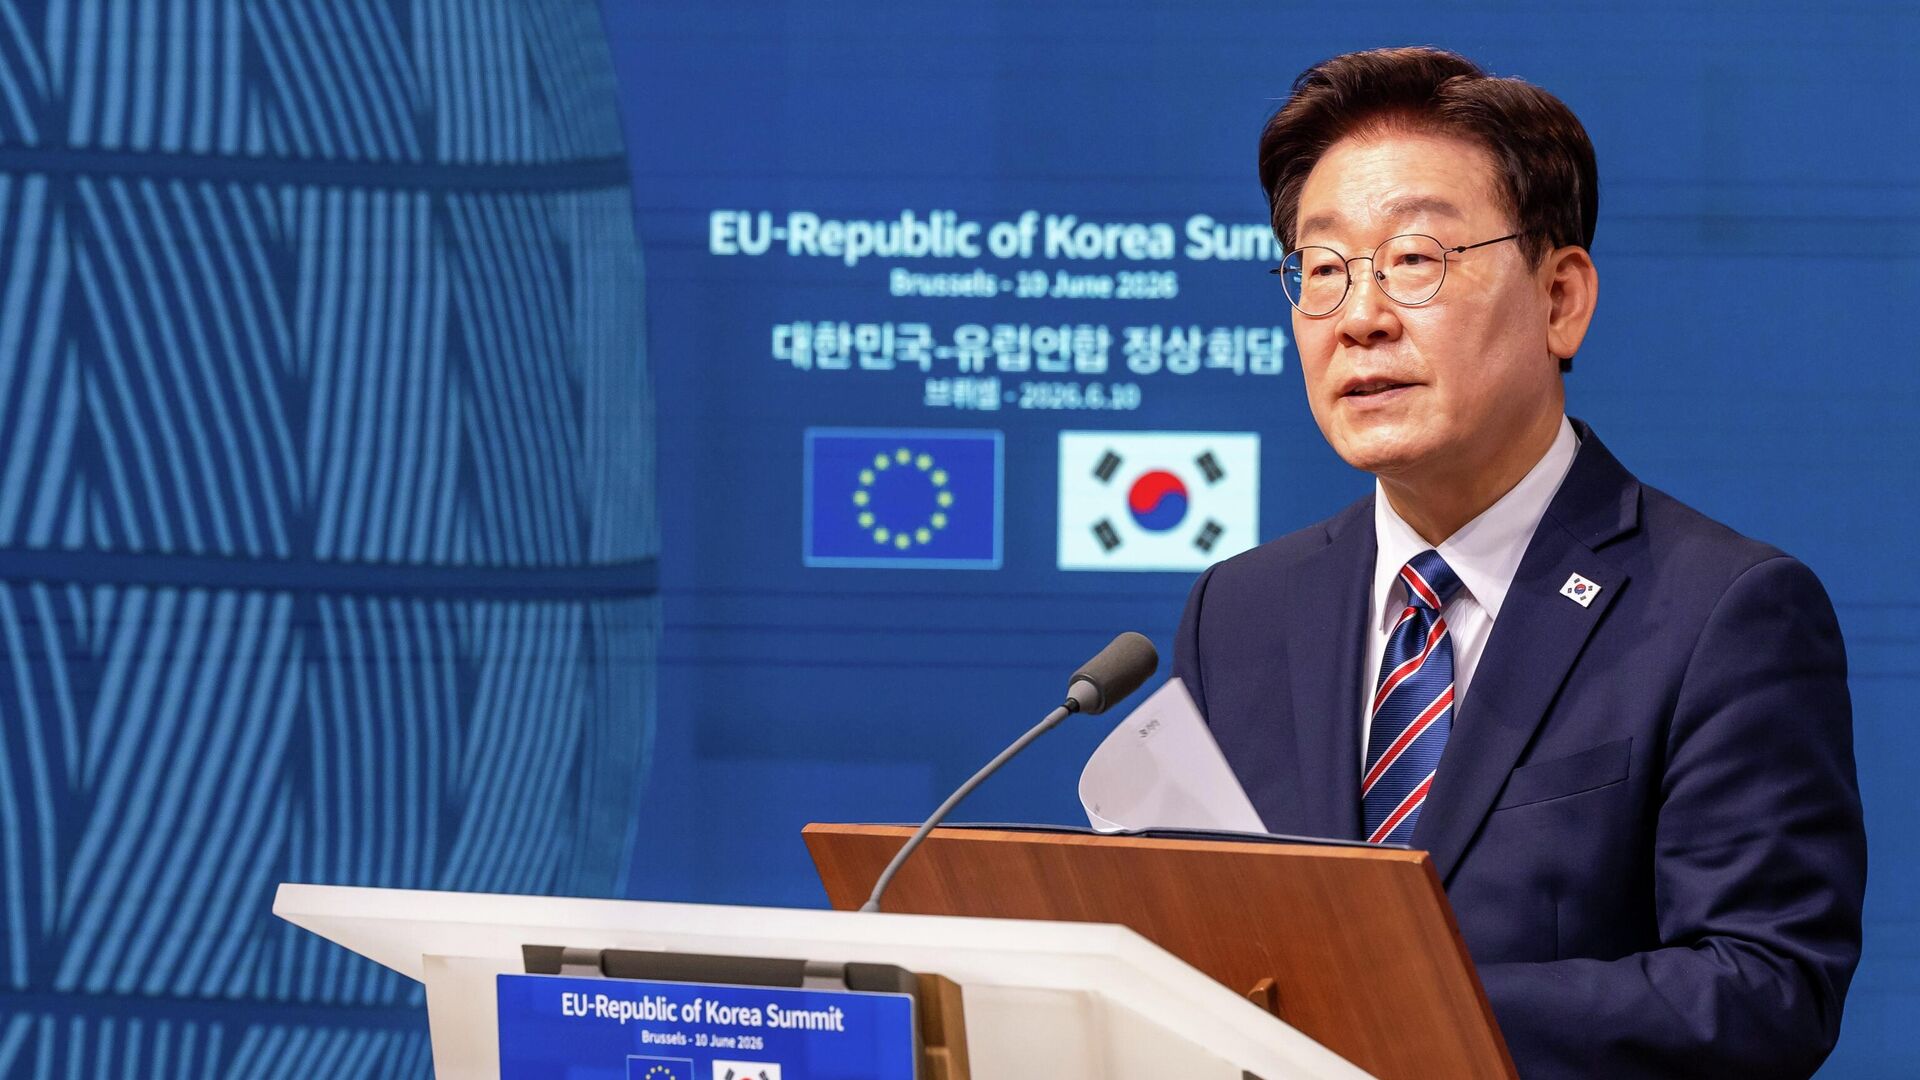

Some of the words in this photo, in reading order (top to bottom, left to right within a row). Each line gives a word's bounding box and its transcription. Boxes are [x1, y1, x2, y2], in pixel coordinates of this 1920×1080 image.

[710, 209, 981, 266] EU-Republic
[988, 210, 1040, 259] of
[1045, 214, 1175, 260] Korea
[890, 268, 998, 298] Brussels
[1015, 270, 1049, 298] 10
[1050, 270, 1114, 298] June
[1115, 270, 1179, 299] 2026
[1123, 325, 1288, 375] 정상회담
[561, 992, 678, 1025] EU-Republic
[681, 997, 703, 1023] of
[705, 1000, 763, 1027] Korea
[766, 1003, 845, 1032] Summit
[641, 1029, 687, 1046] Brussels
[694, 1033, 708, 1048] 10
[710, 1034, 736, 1049] June
[737, 1035, 764, 1051] 2026
